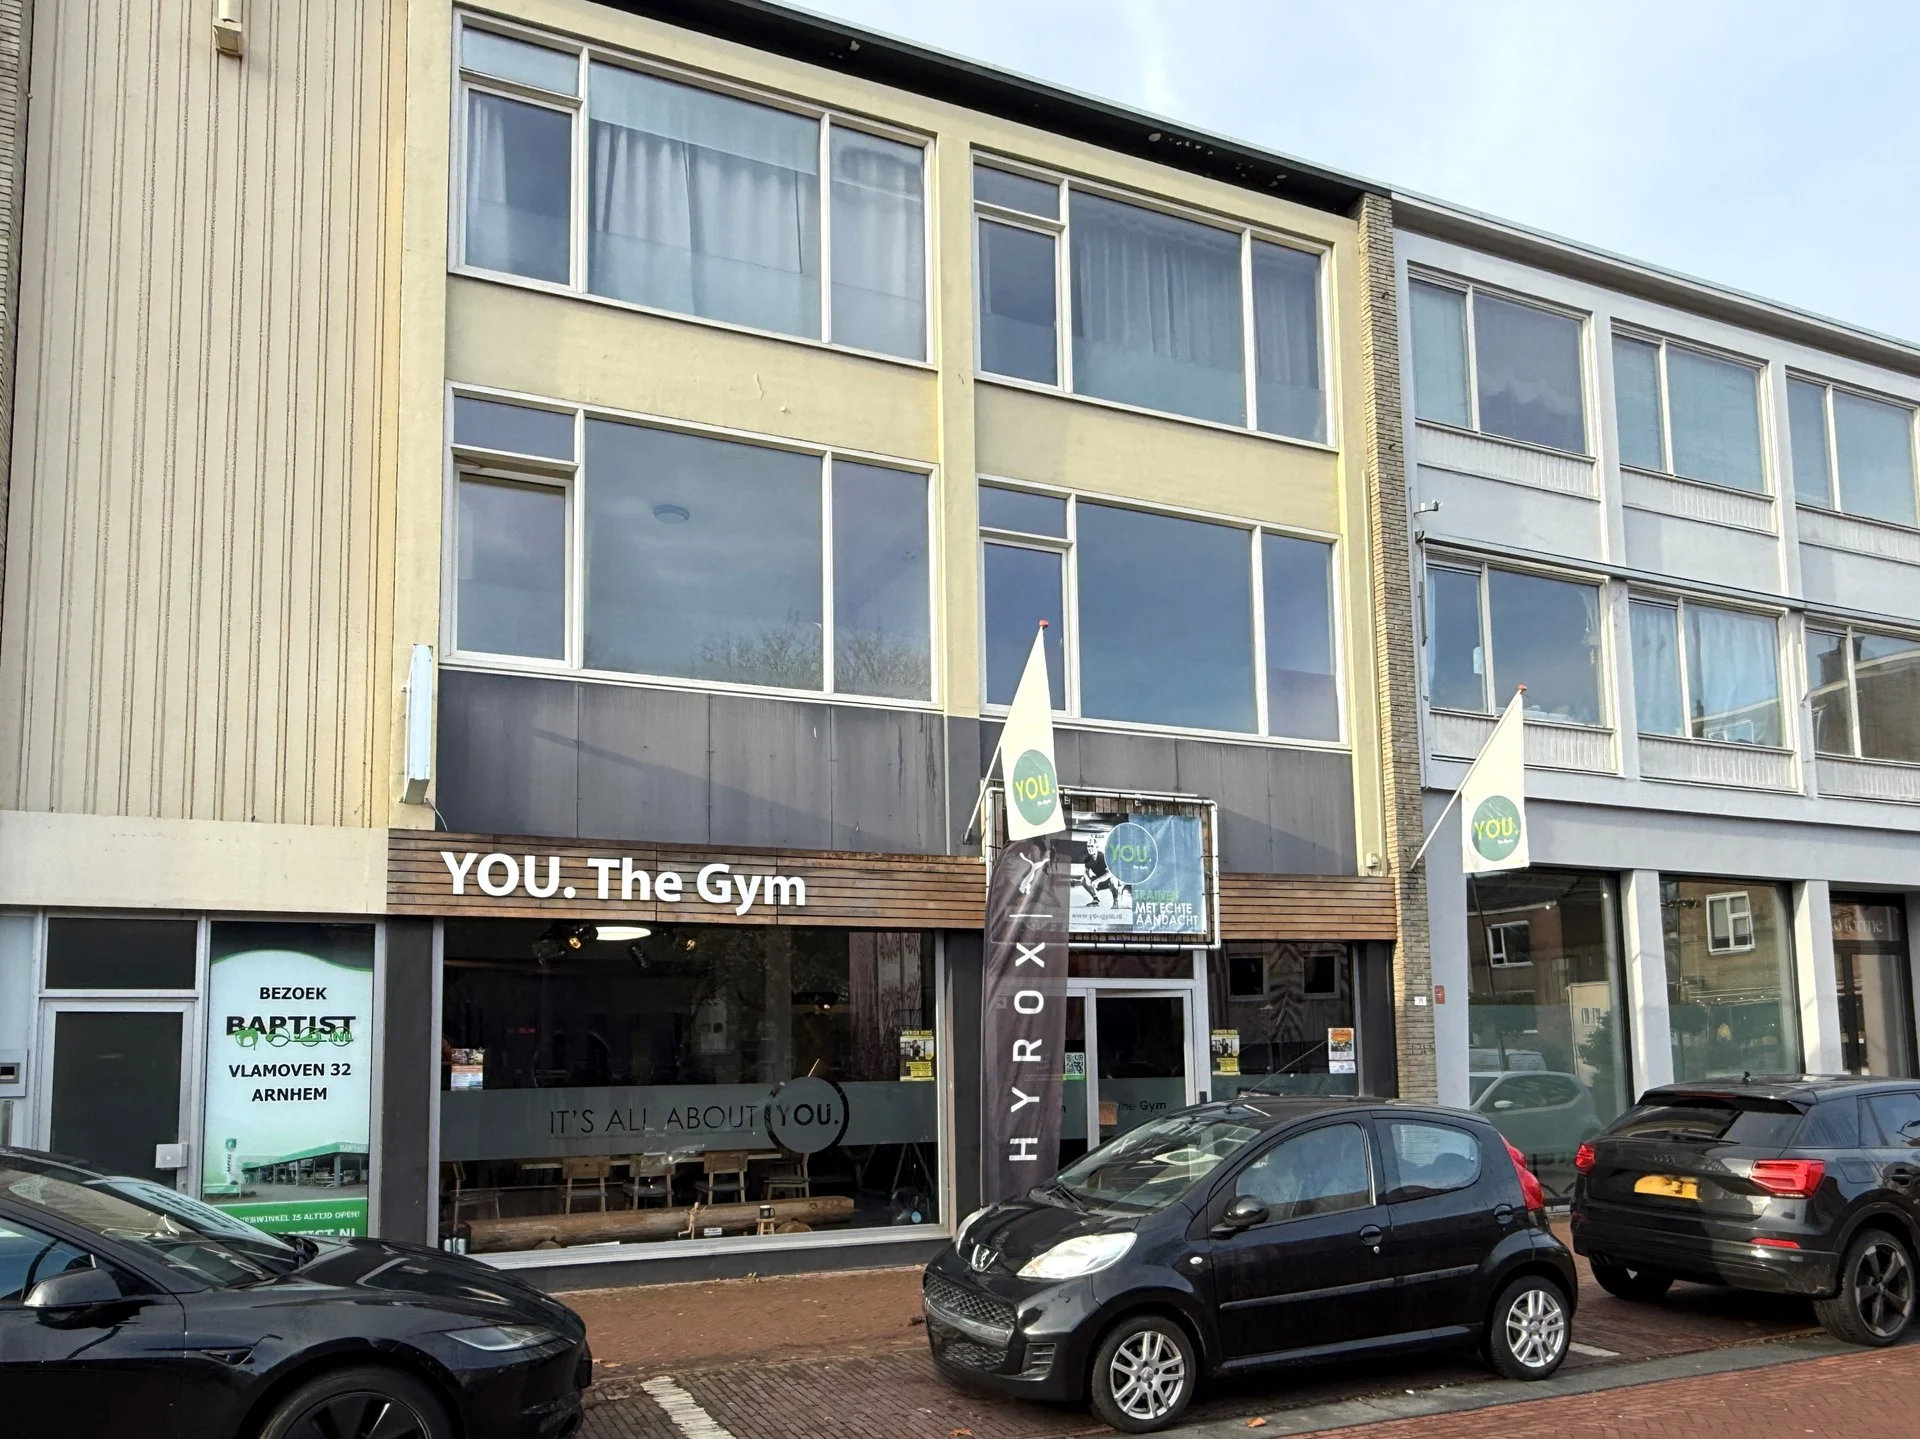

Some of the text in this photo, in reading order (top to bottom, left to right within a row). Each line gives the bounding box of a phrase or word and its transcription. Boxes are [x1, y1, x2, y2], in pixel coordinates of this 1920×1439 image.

[1015, 773, 1056, 802] YOU.
[1474, 816, 1519, 840] YOU.
[440, 851, 806, 916] YOU. The Gym
[1134, 901, 1192, 914] MET ECHTE
[1136, 914, 1199, 927] AANDACHT
[259, 987, 327, 1000] BEZOEK
[226, 1016, 357, 1036] BAPTIST
[1008, 942, 1045, 1161] HYROX
[228, 1063, 352, 1078] VLAMOVEN 32
[251, 1087, 327, 1102] ARNHEM
[1139, 1100, 1167, 1113] Gym
[550, 1109, 594, 1134] IT'S
[666, 1105, 758, 1130] ABOUT
[775, 1103, 840, 1127] YOU.
